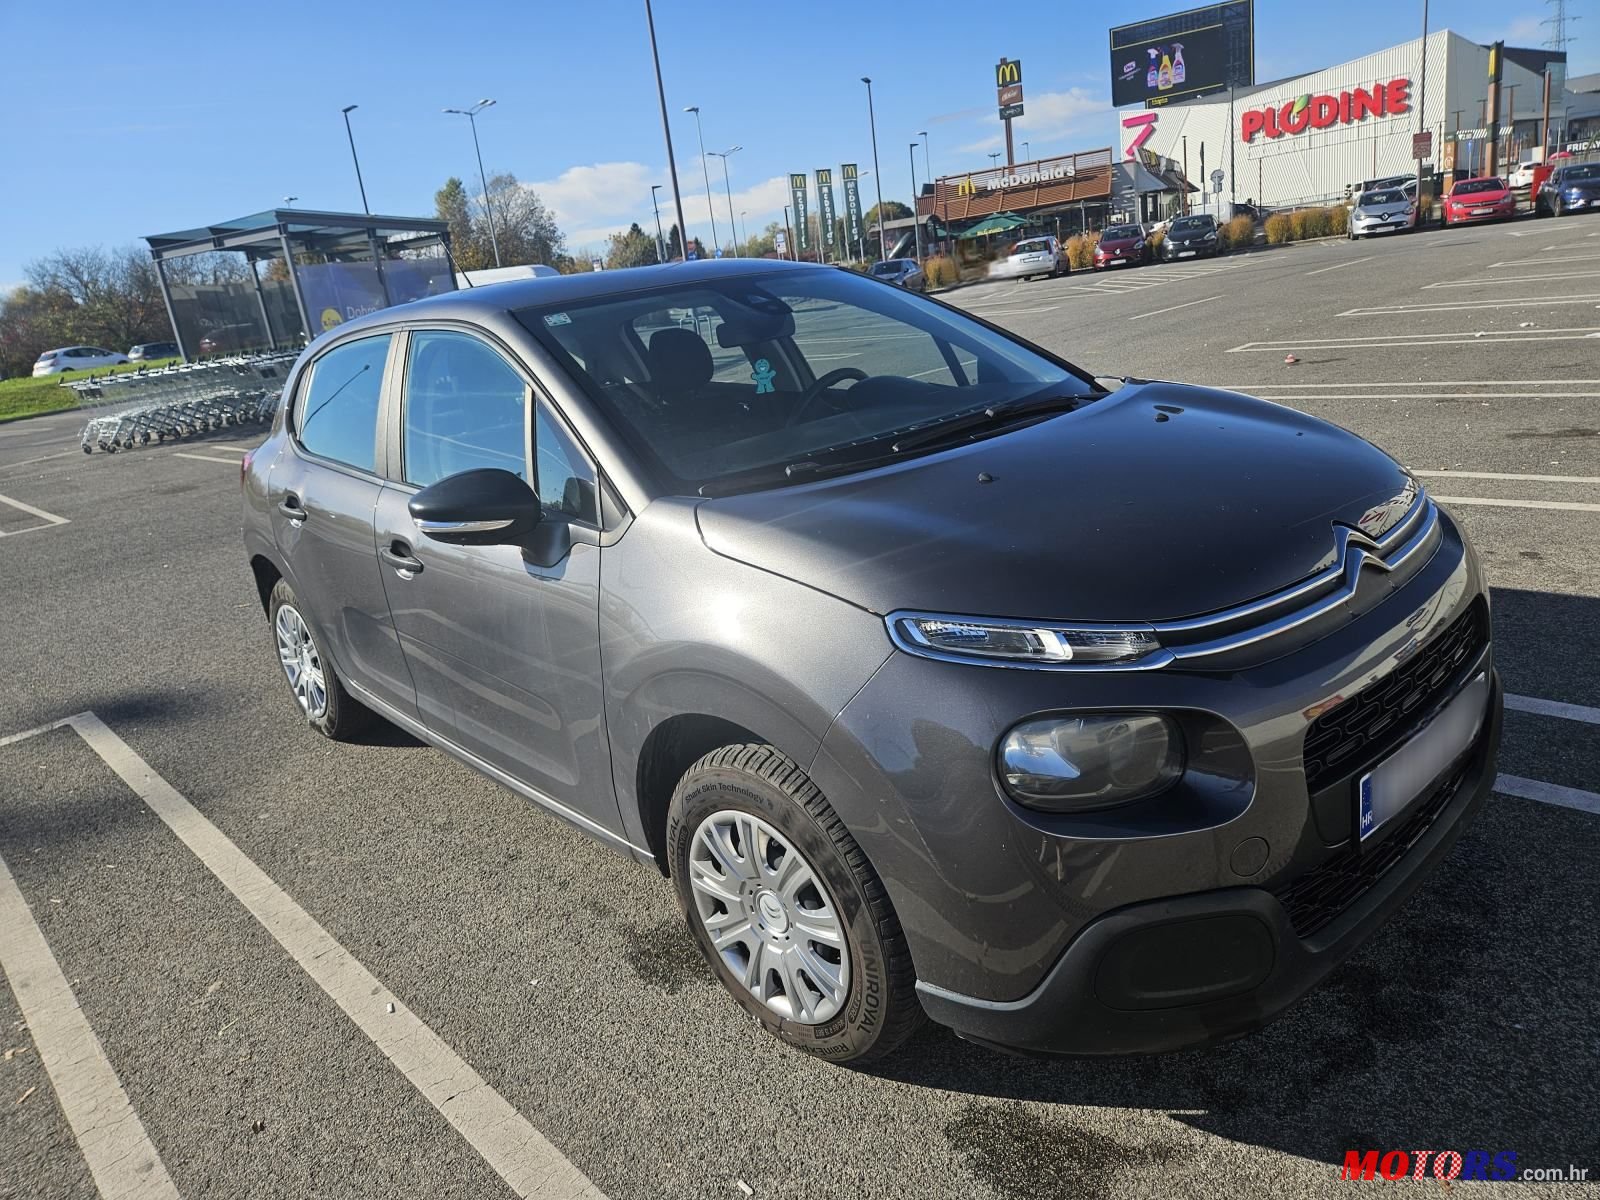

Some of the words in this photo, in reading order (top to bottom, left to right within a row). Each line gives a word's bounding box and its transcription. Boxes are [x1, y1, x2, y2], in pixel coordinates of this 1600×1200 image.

[1241, 78, 1410, 143] PLODINE
[987, 165, 1076, 190] McDonald's
[685, 787, 701, 802] Shark
[702, 783, 717, 793] Skin
[718, 782, 765, 804] Technology
[1361, 810, 1373, 830] HR
[857, 940, 880, 1034] UNIROYAL
